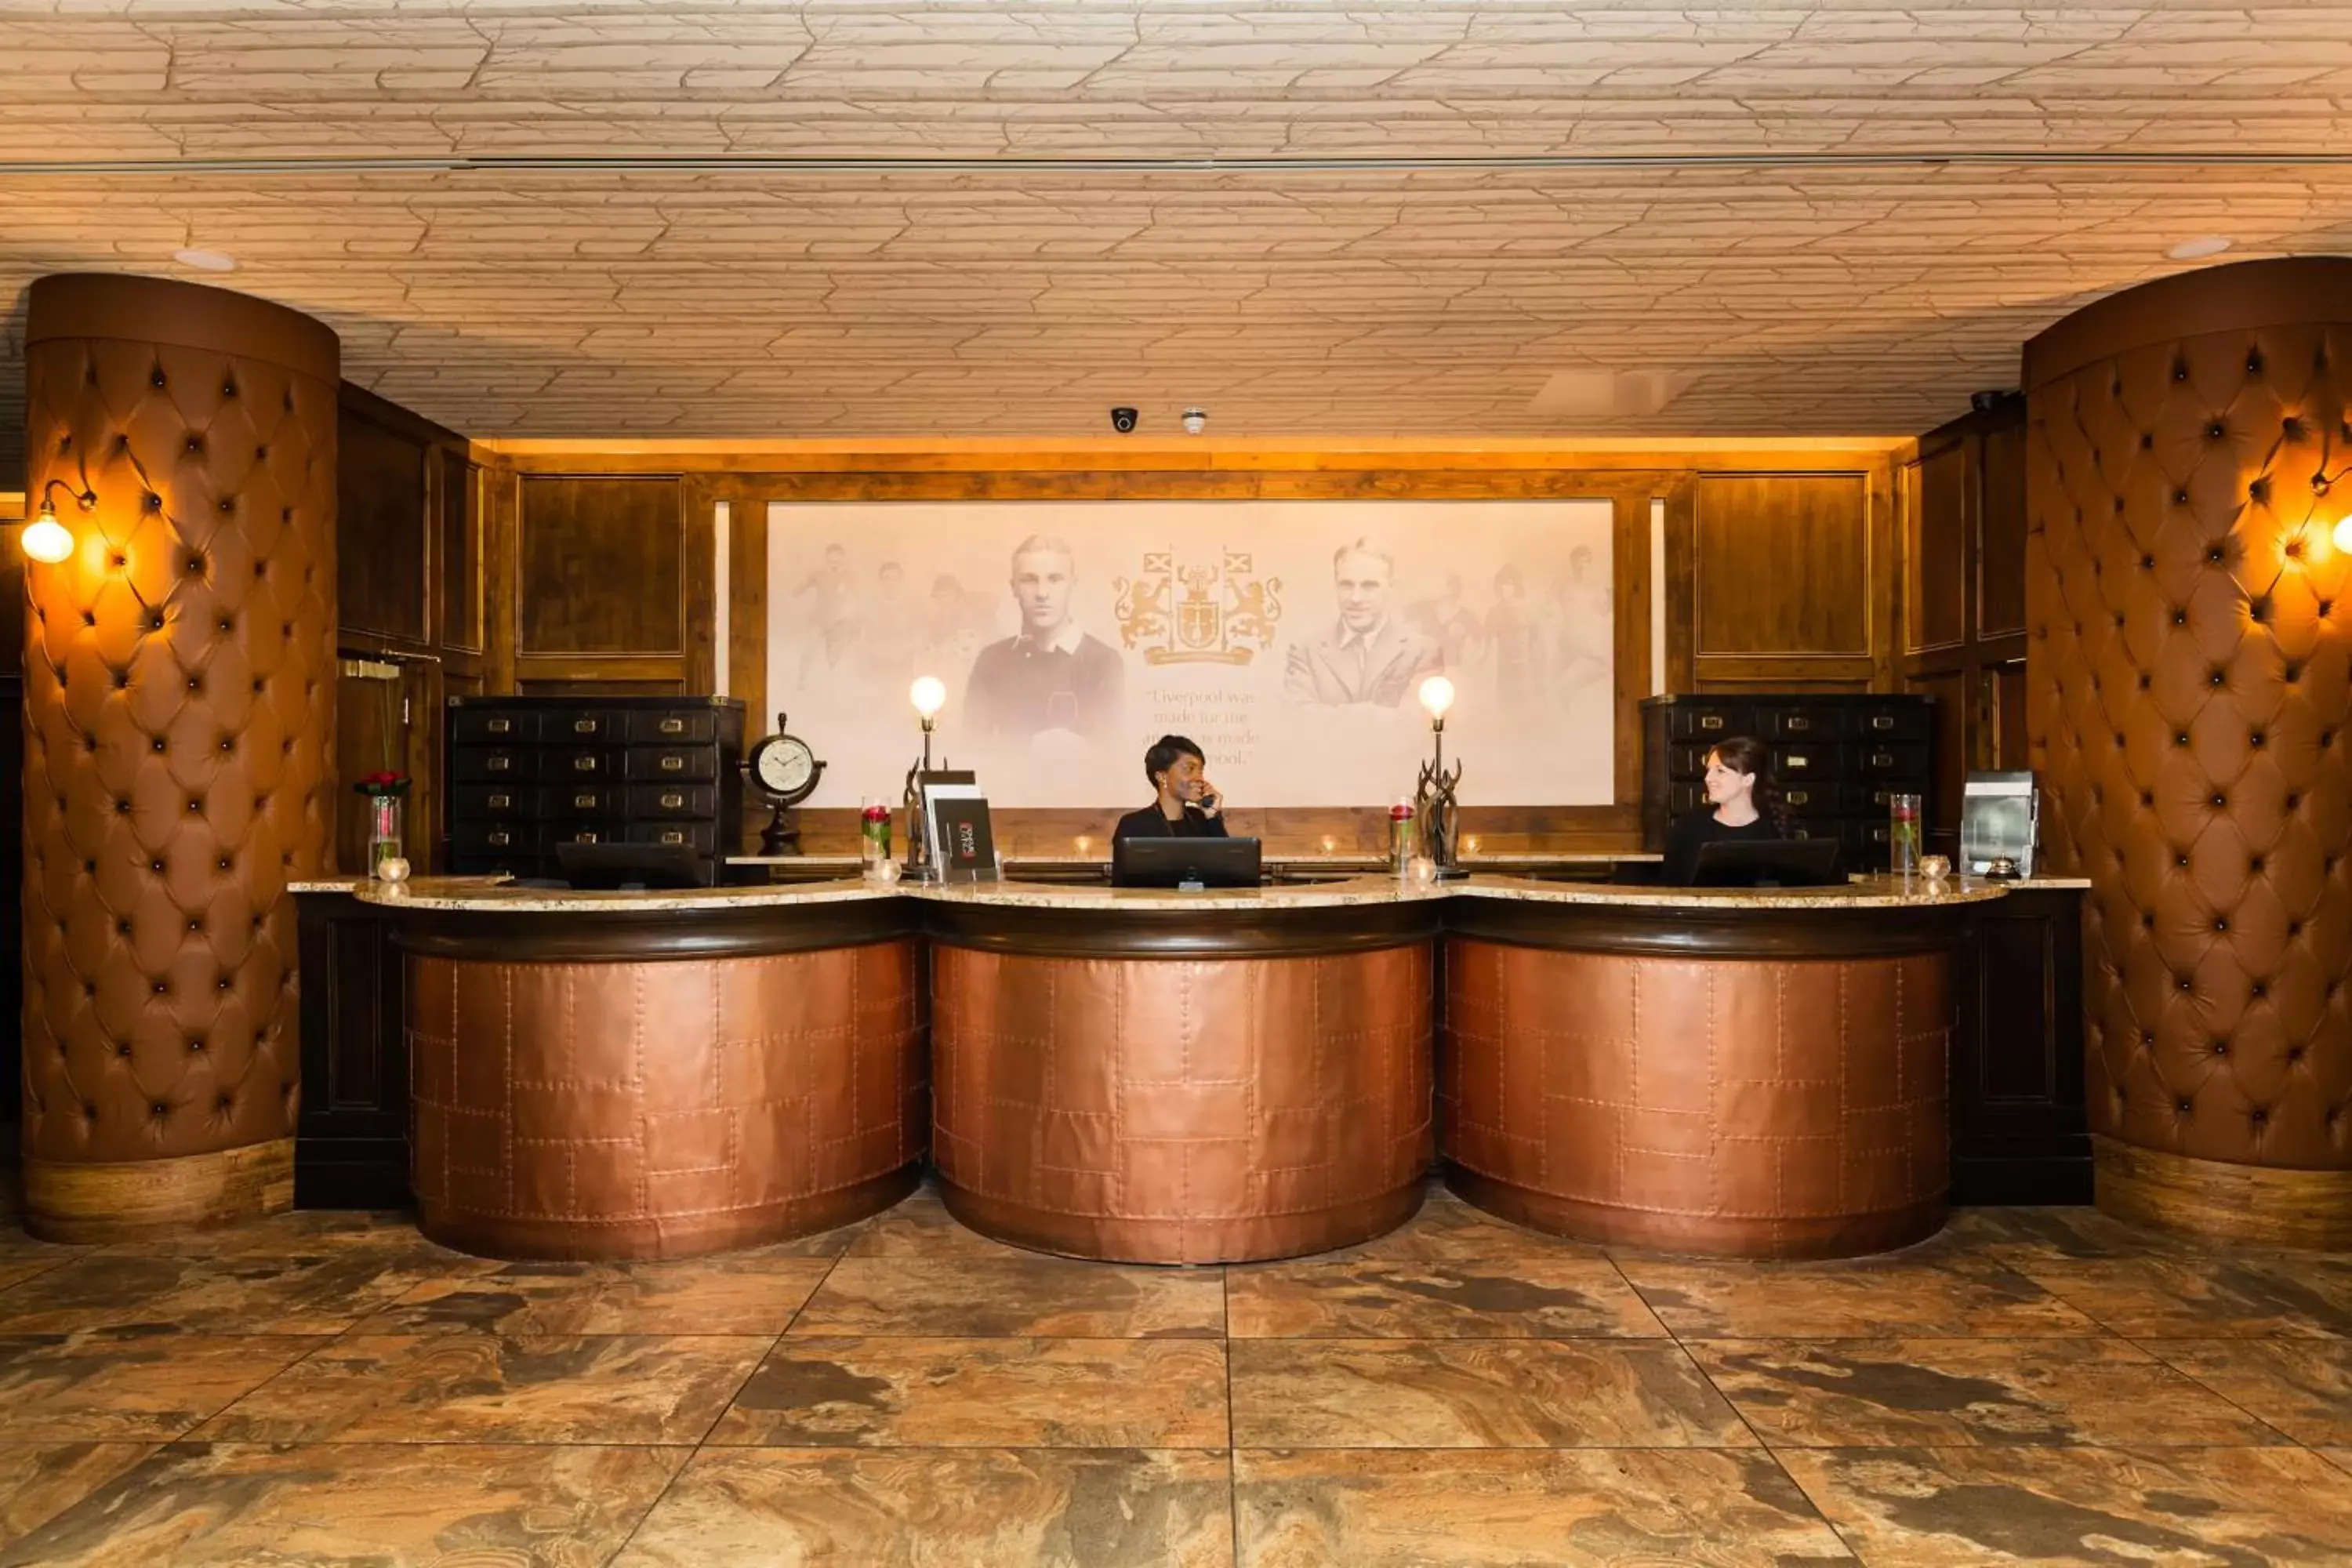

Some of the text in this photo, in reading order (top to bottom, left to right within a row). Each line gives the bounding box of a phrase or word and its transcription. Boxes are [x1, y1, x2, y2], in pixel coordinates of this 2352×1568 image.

[1227, 692, 1256, 703] was
[1153, 709, 1195, 723] made
[1225, 713, 1248, 723] me
[1217, 728, 1260, 744] made
